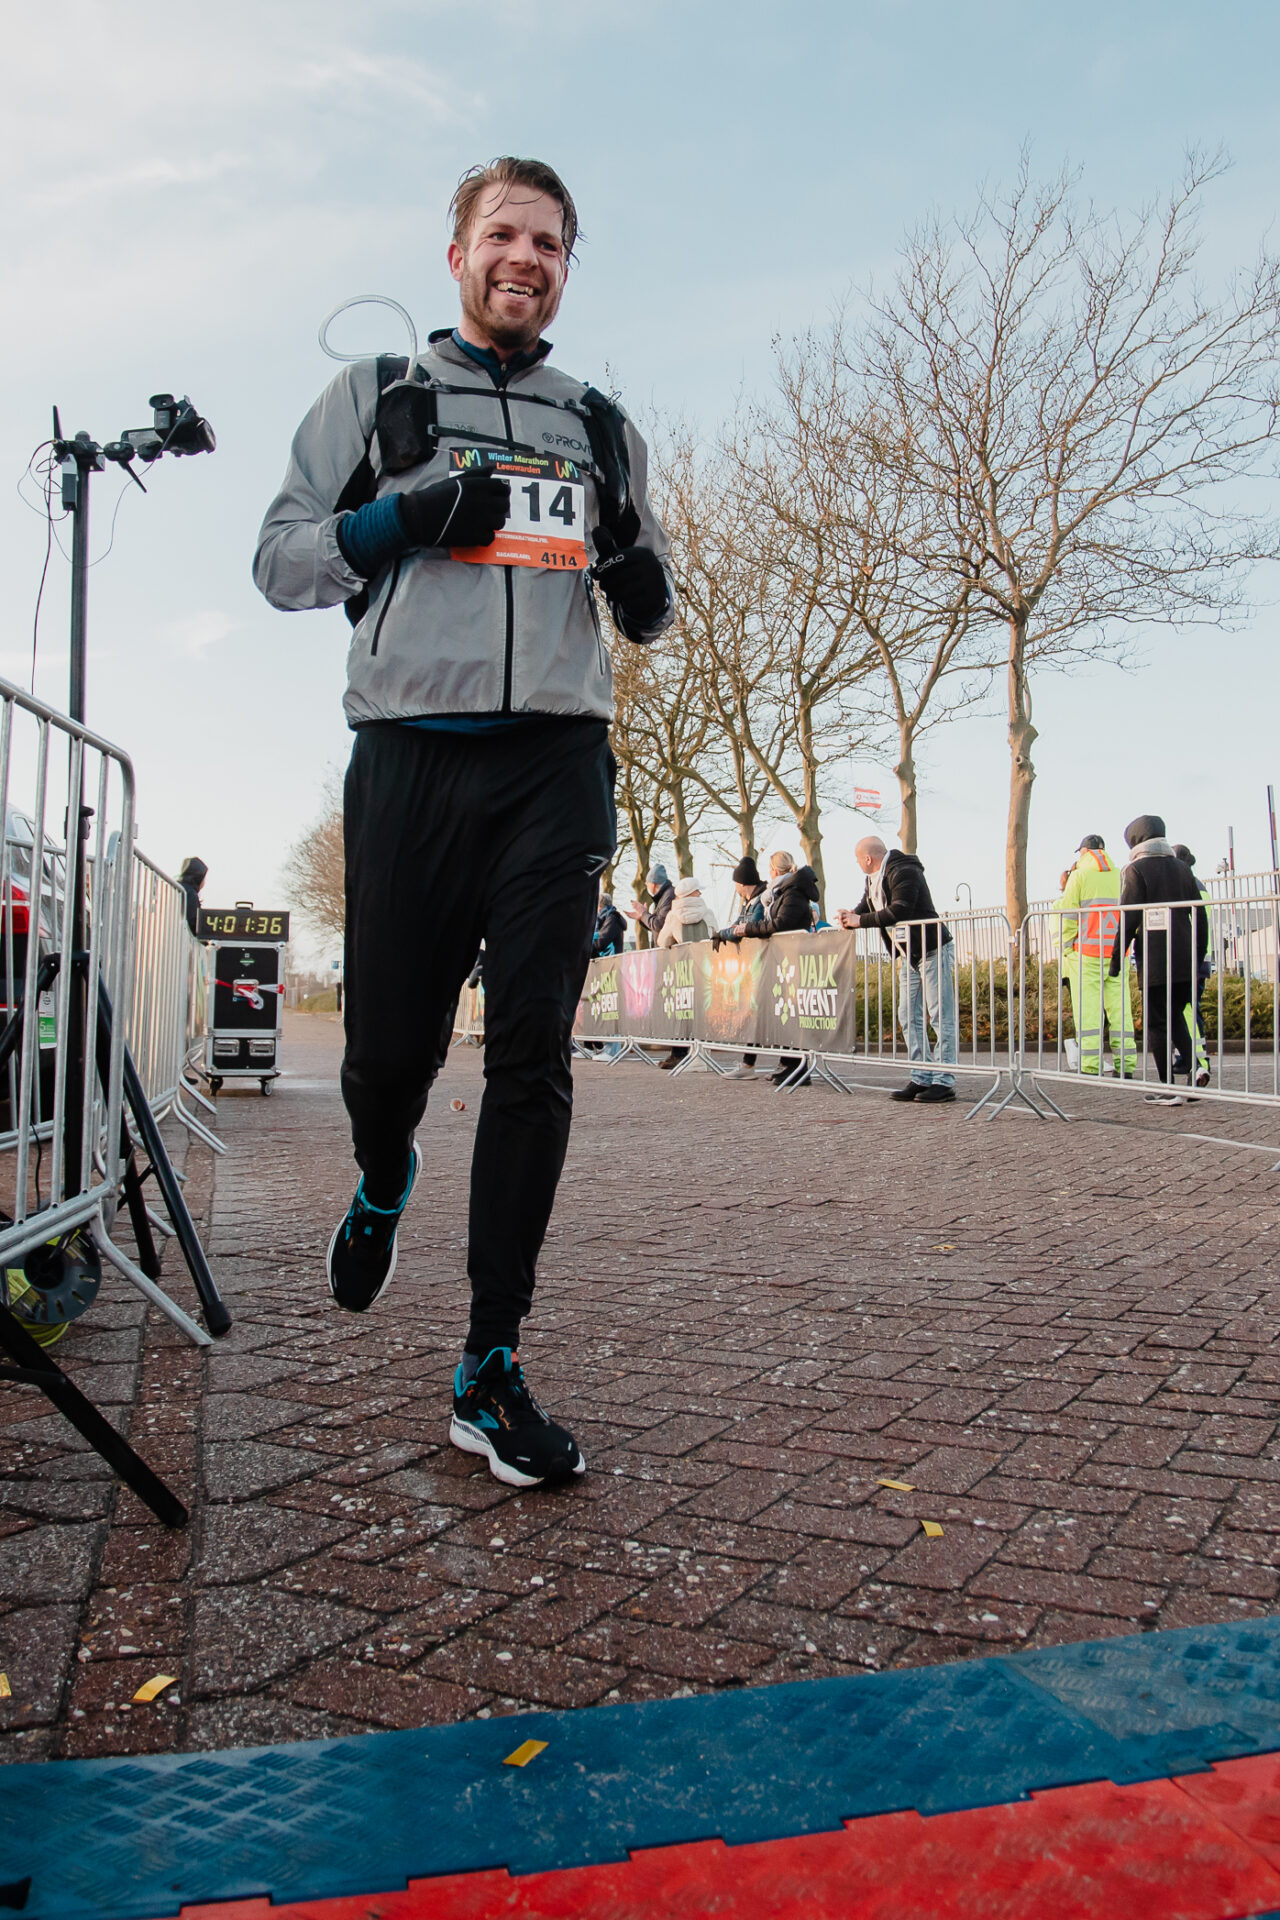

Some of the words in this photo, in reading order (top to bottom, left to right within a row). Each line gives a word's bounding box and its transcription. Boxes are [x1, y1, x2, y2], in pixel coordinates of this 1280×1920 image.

[555, 434, 592, 455] PROVI
[488, 452, 513, 462] Winter
[514, 455, 549, 466] Marathon
[496, 462, 541, 475] Leeuwarden
[505, 481, 576, 526] 14
[541, 552, 578, 567] 4114
[206, 915, 283, 935] 4:01:36
[799, 954, 838, 988] VALK
[796, 988, 838, 1017] EVENT
